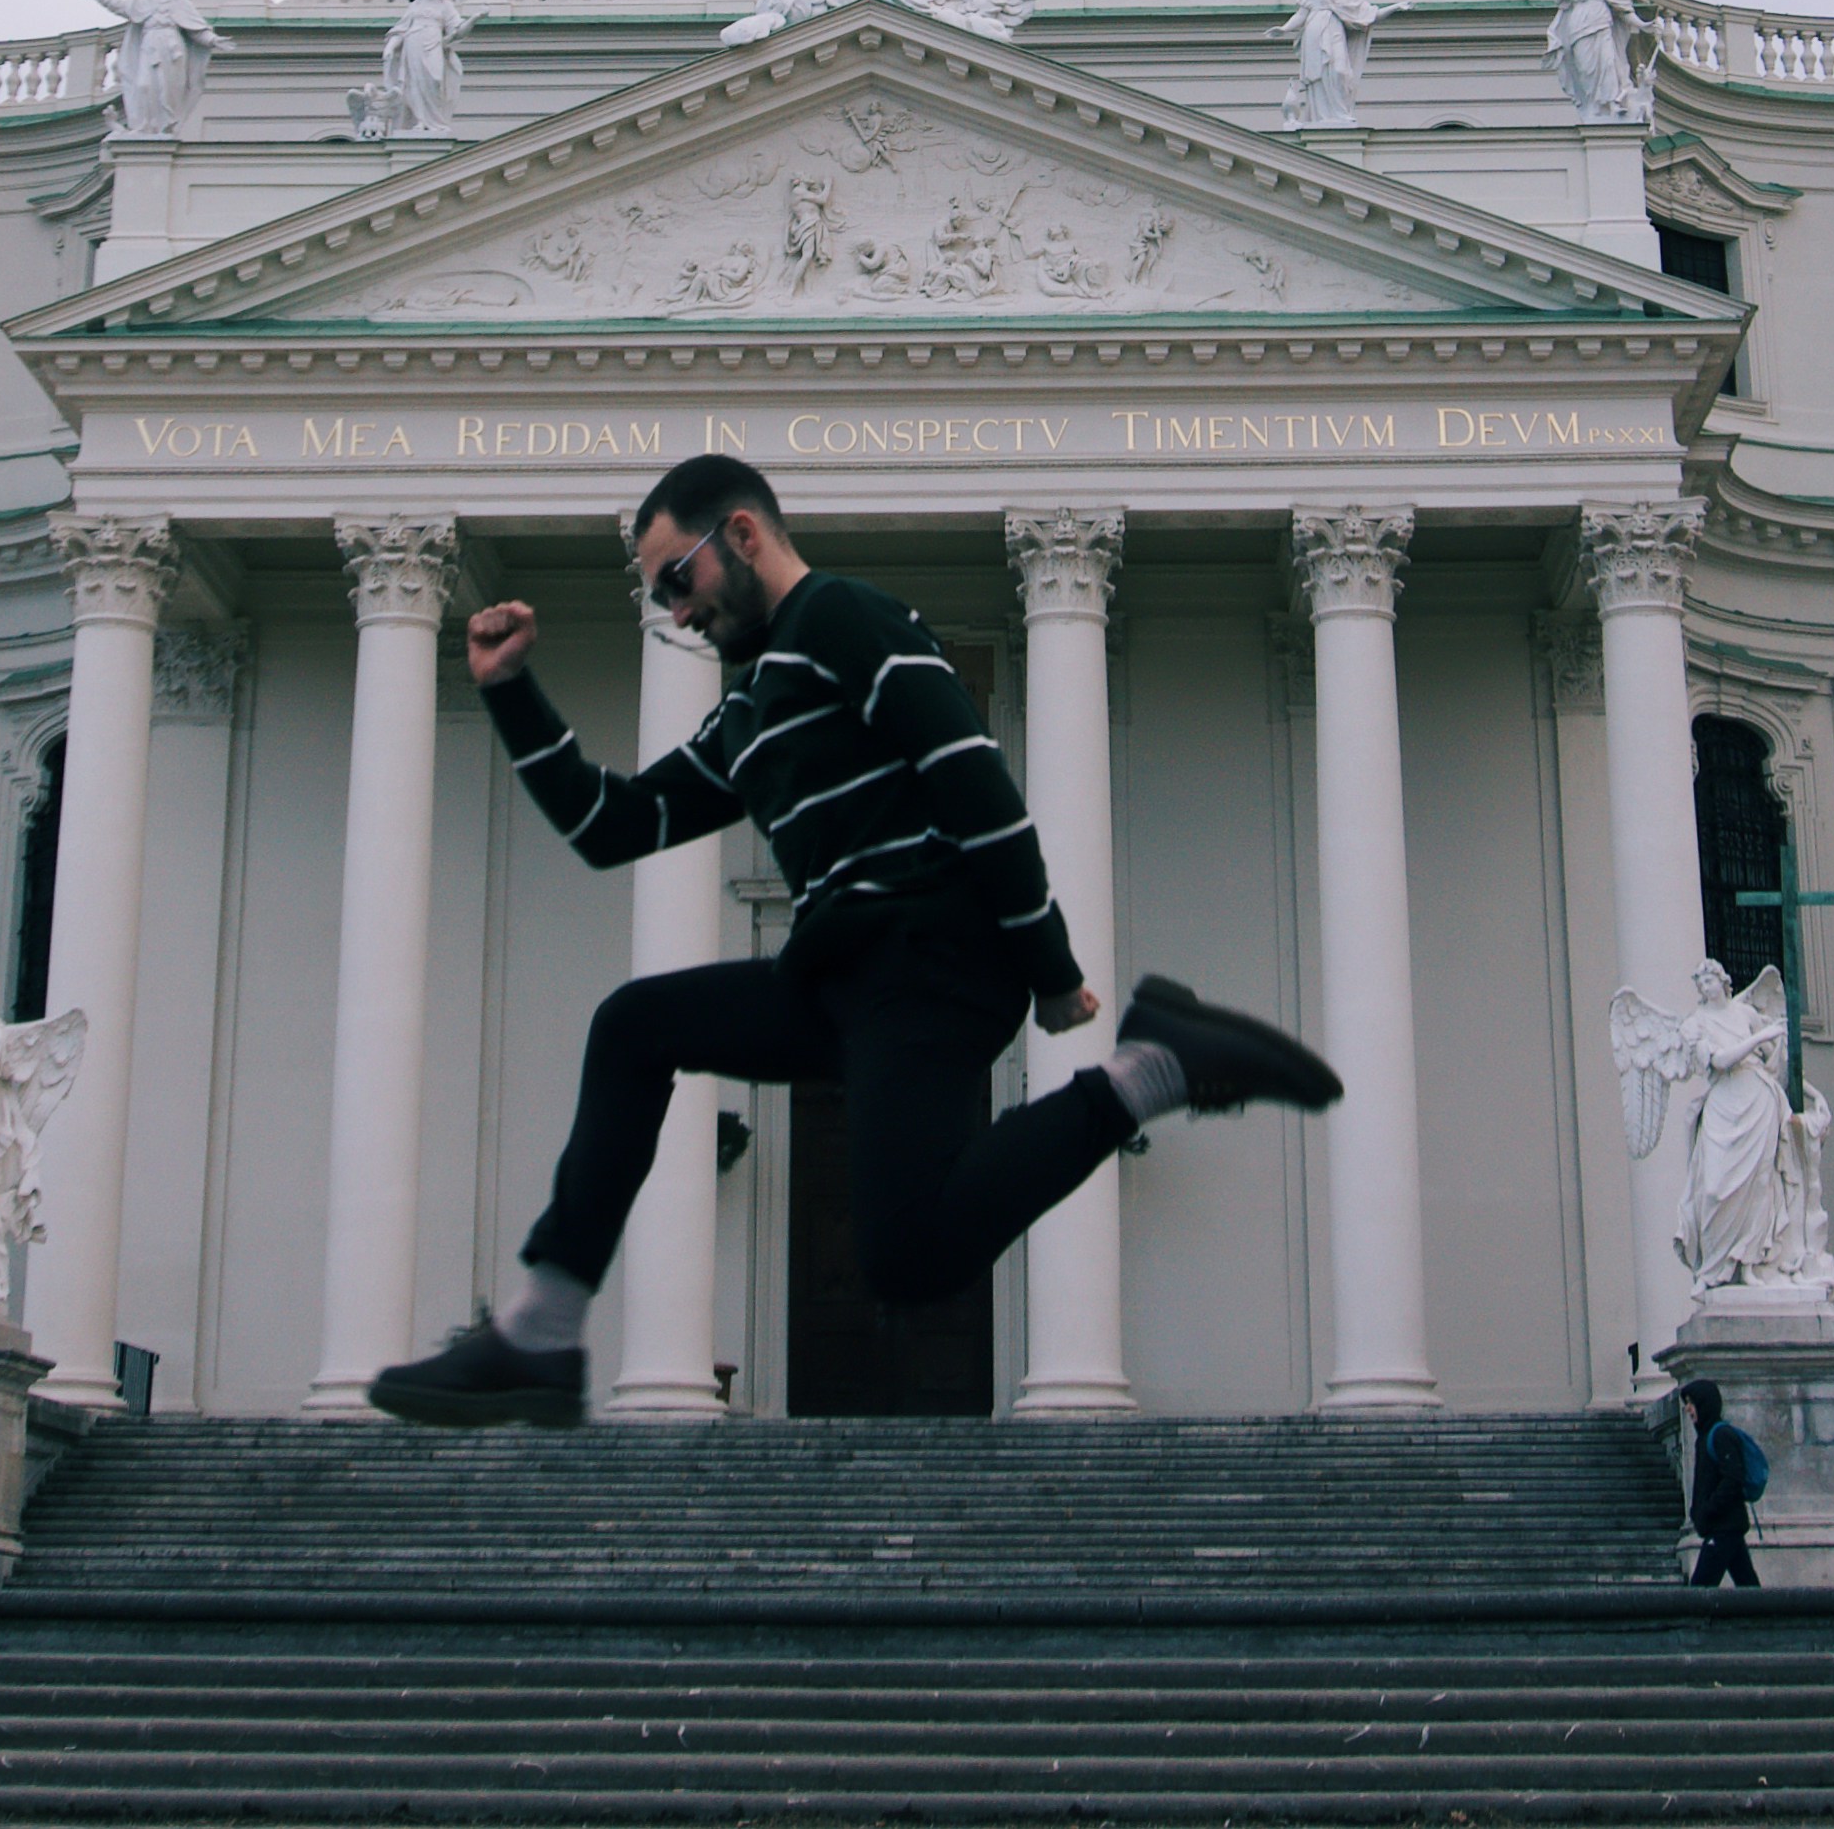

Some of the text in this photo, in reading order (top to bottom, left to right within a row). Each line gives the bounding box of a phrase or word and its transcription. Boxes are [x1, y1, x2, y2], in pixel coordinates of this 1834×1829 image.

[302, 418, 413, 457] MEA
[456, 416, 663, 456] REDDAM
[788, 413, 1069, 454] CONSPECTV
[1112, 410, 1396, 450] TIMENTIVM
